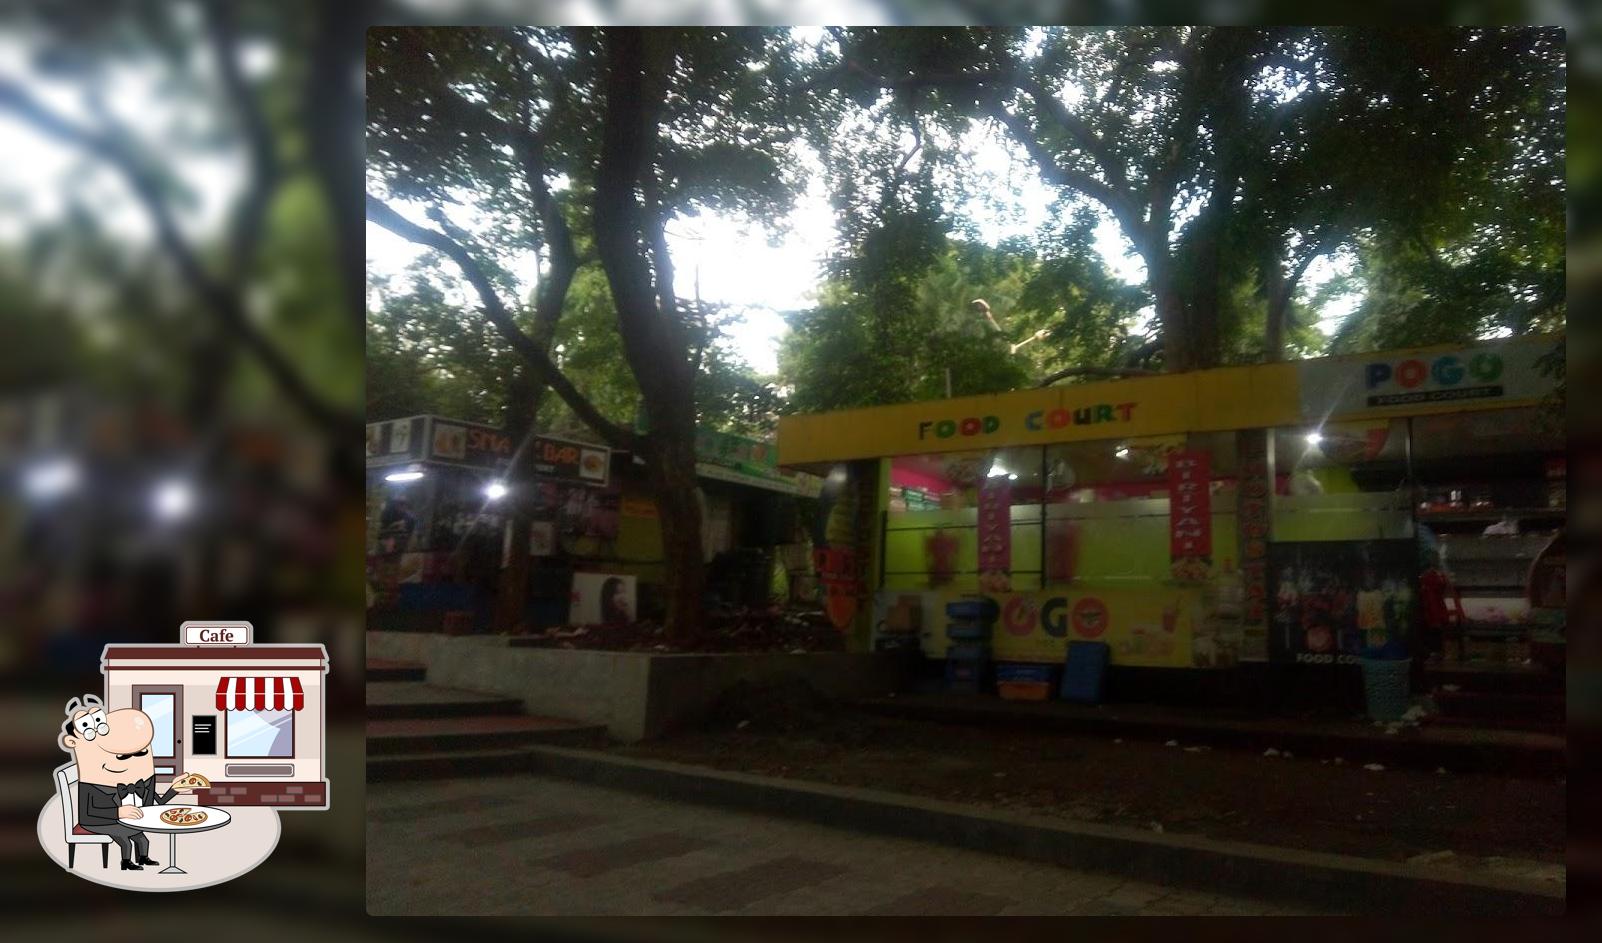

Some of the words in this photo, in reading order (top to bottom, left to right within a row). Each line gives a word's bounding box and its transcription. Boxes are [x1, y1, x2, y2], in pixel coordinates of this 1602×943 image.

[1367, 352, 1503, 388] POGO
[919, 415, 1000, 440] FOOD
[1025, 402, 1138, 432] COURT
[1295, 652, 1334, 664] FOOD
